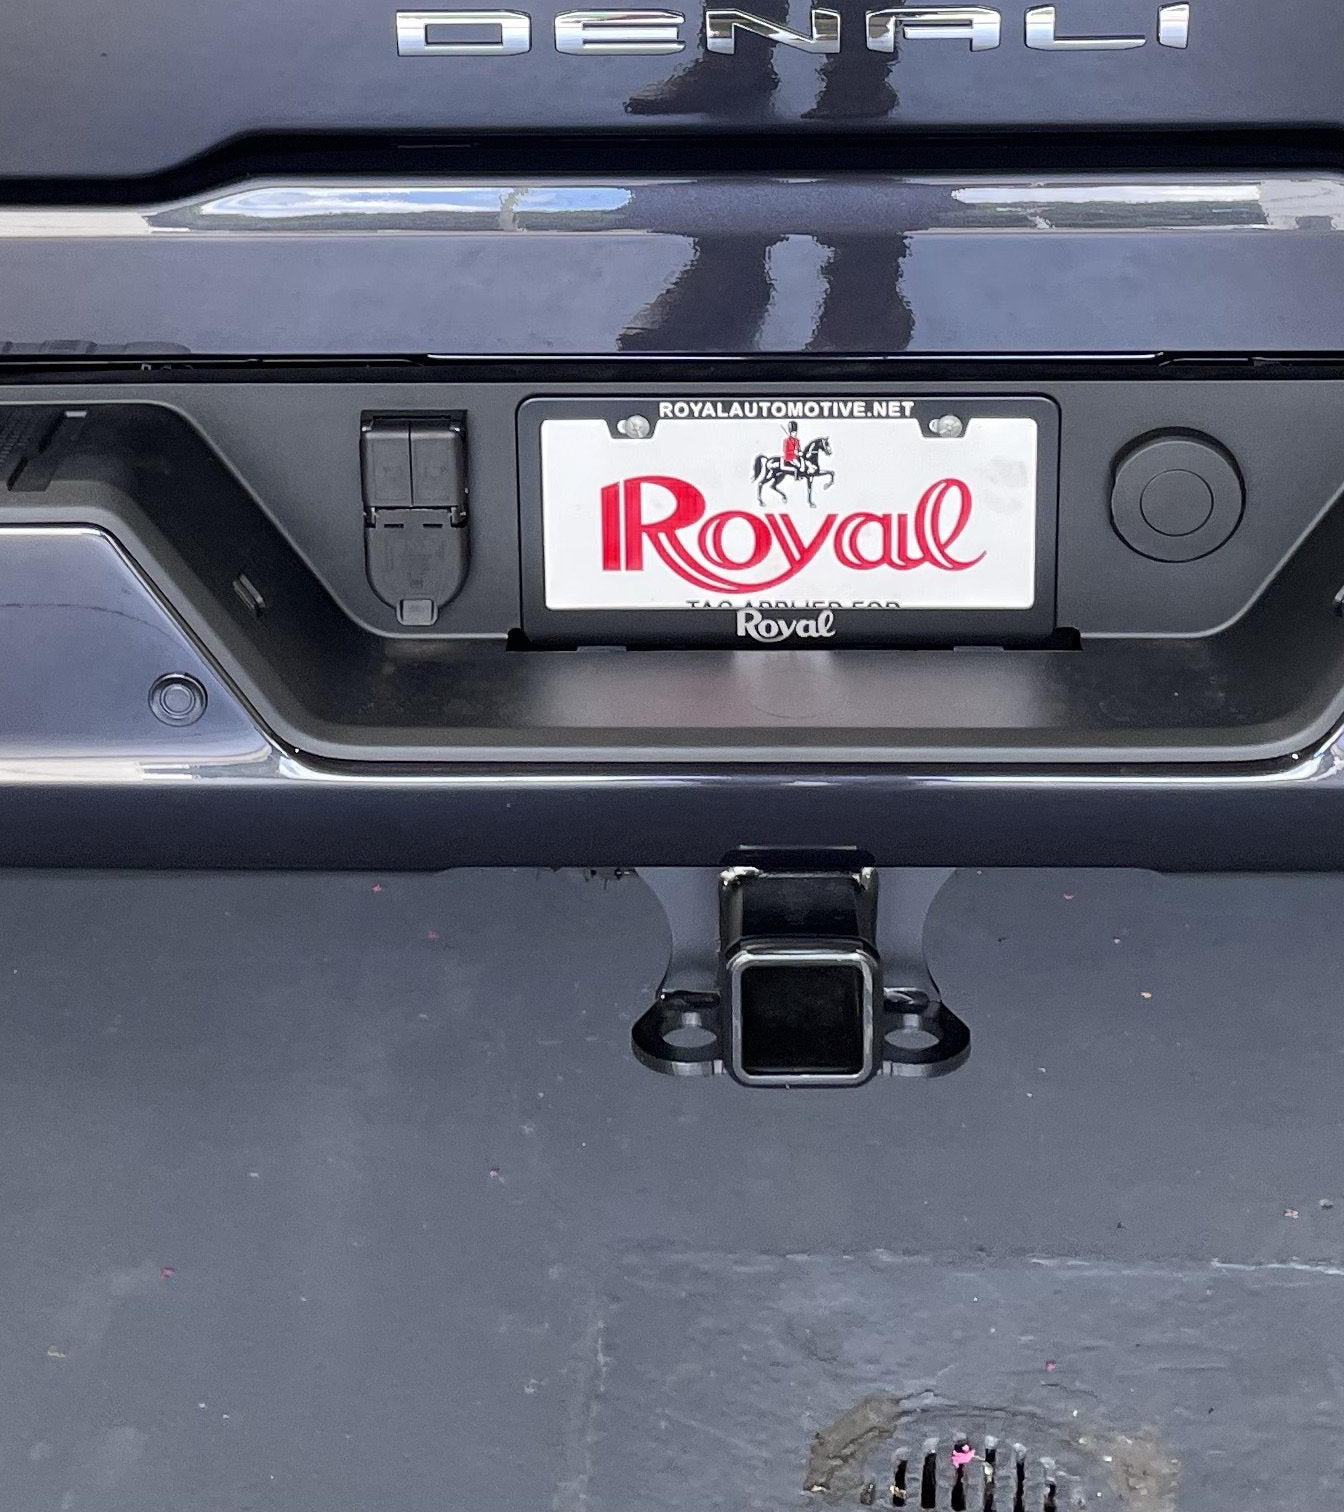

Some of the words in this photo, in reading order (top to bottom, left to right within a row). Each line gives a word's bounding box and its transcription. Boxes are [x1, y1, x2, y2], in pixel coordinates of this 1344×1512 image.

[395, 1, 1190, 57] DENALI
[658, 400, 915, 418] ROYALAUTOMOTIVE.NET
[600, 475, 987, 594] Royal
[736, 608, 837, 643] Royal
